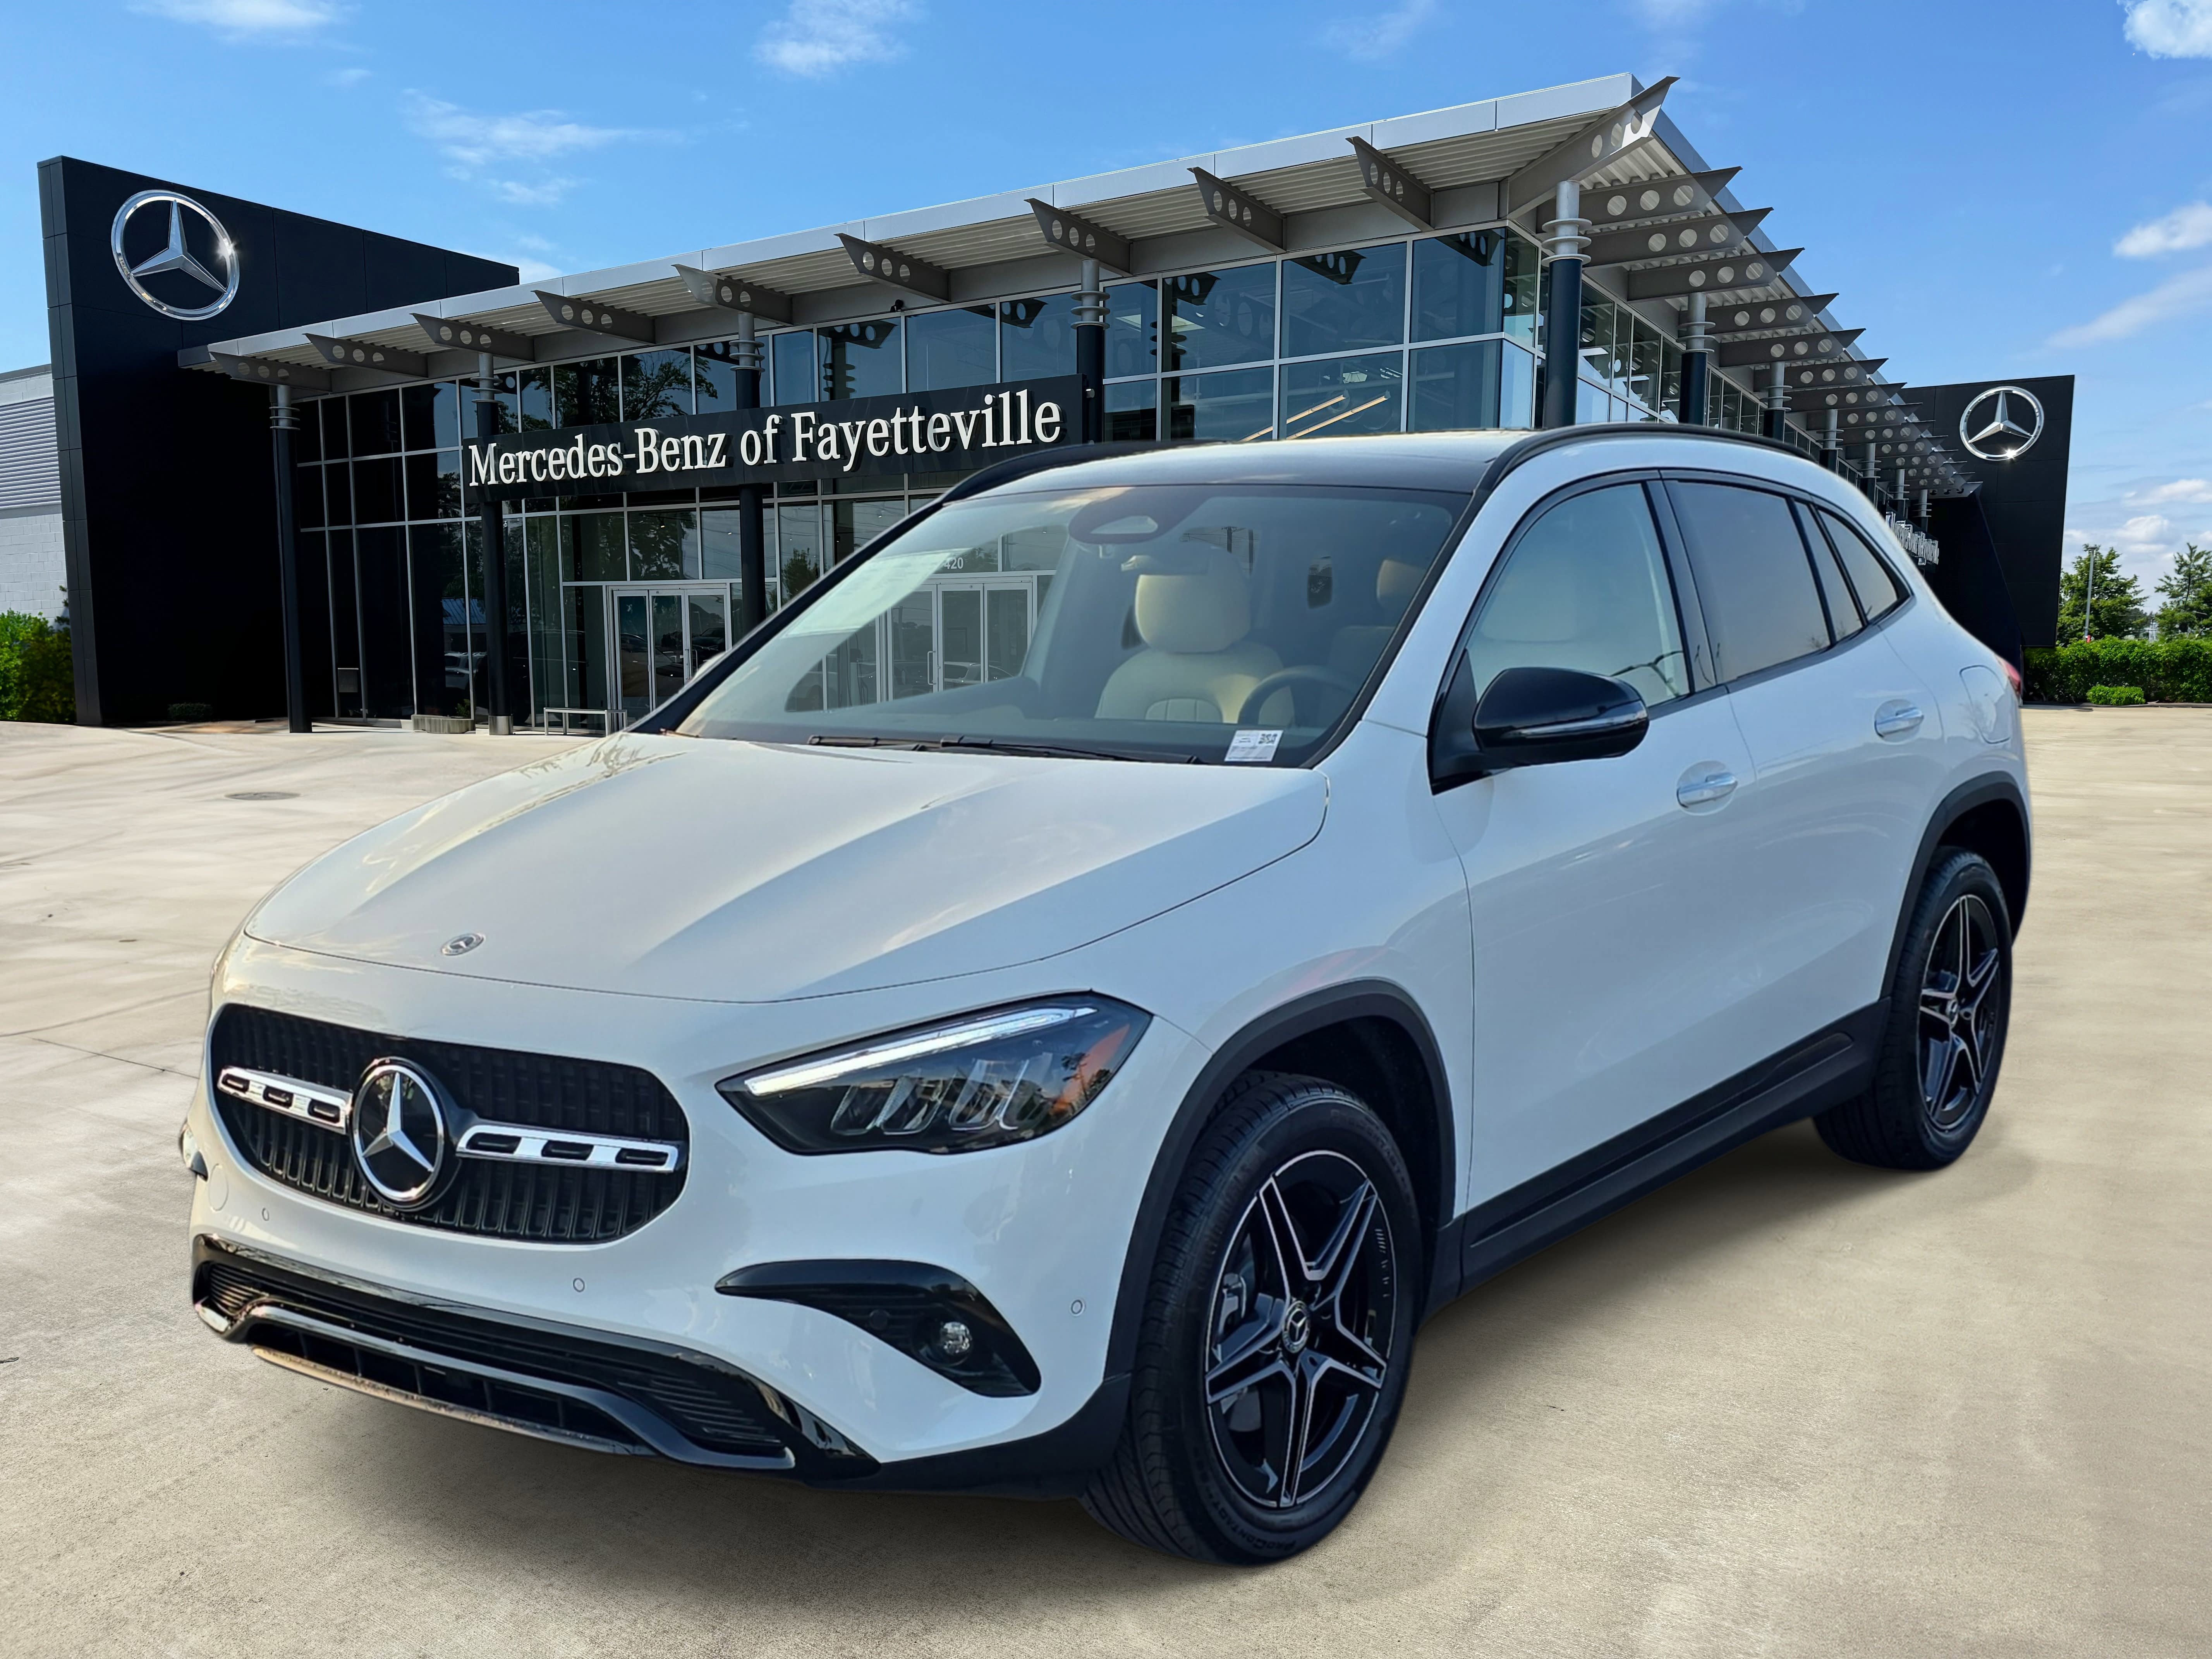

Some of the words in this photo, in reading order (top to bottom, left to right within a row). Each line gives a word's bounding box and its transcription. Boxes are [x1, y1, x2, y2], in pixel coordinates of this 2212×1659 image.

[469, 428, 726, 486] Mercedes-Benz
[740, 414, 782, 465] of
[791, 389, 1060, 472] Fayetteville
